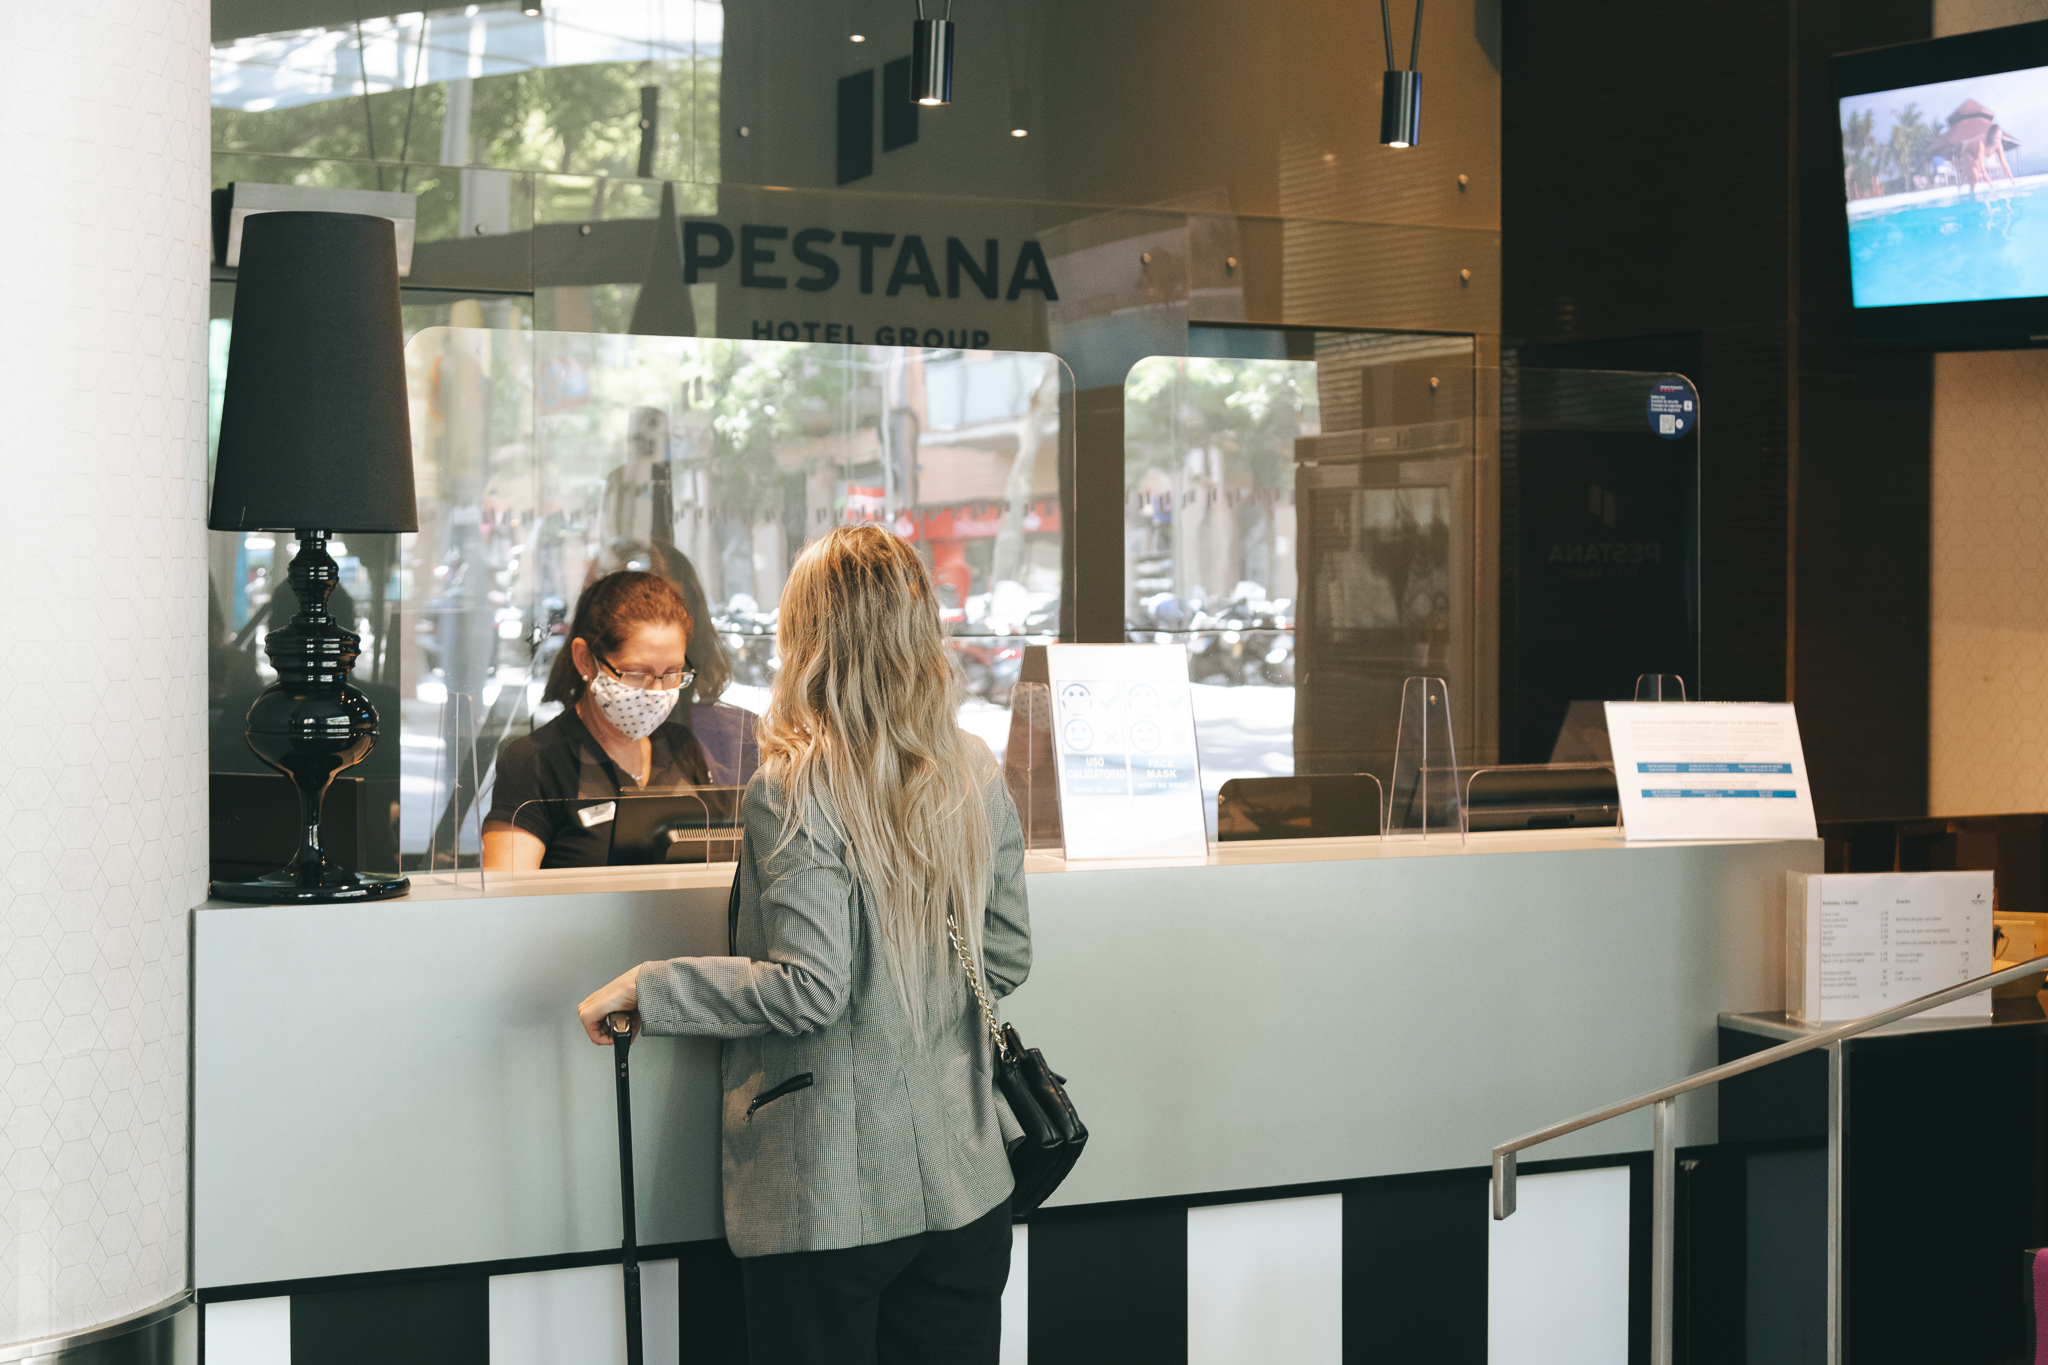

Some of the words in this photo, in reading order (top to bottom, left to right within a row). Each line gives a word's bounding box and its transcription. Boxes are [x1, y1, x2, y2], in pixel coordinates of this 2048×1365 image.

[683, 220, 1058, 302] PESTANA
[752, 319, 863, 345] HOTEL
[875, 325, 991, 350] GROUP
[1086, 756, 1105, 768] USO
[1148, 758, 1175, 768] FACE
[1067, 768, 1126, 780] OBLIGATORIO
[1146, 769, 1178, 779] MASK
